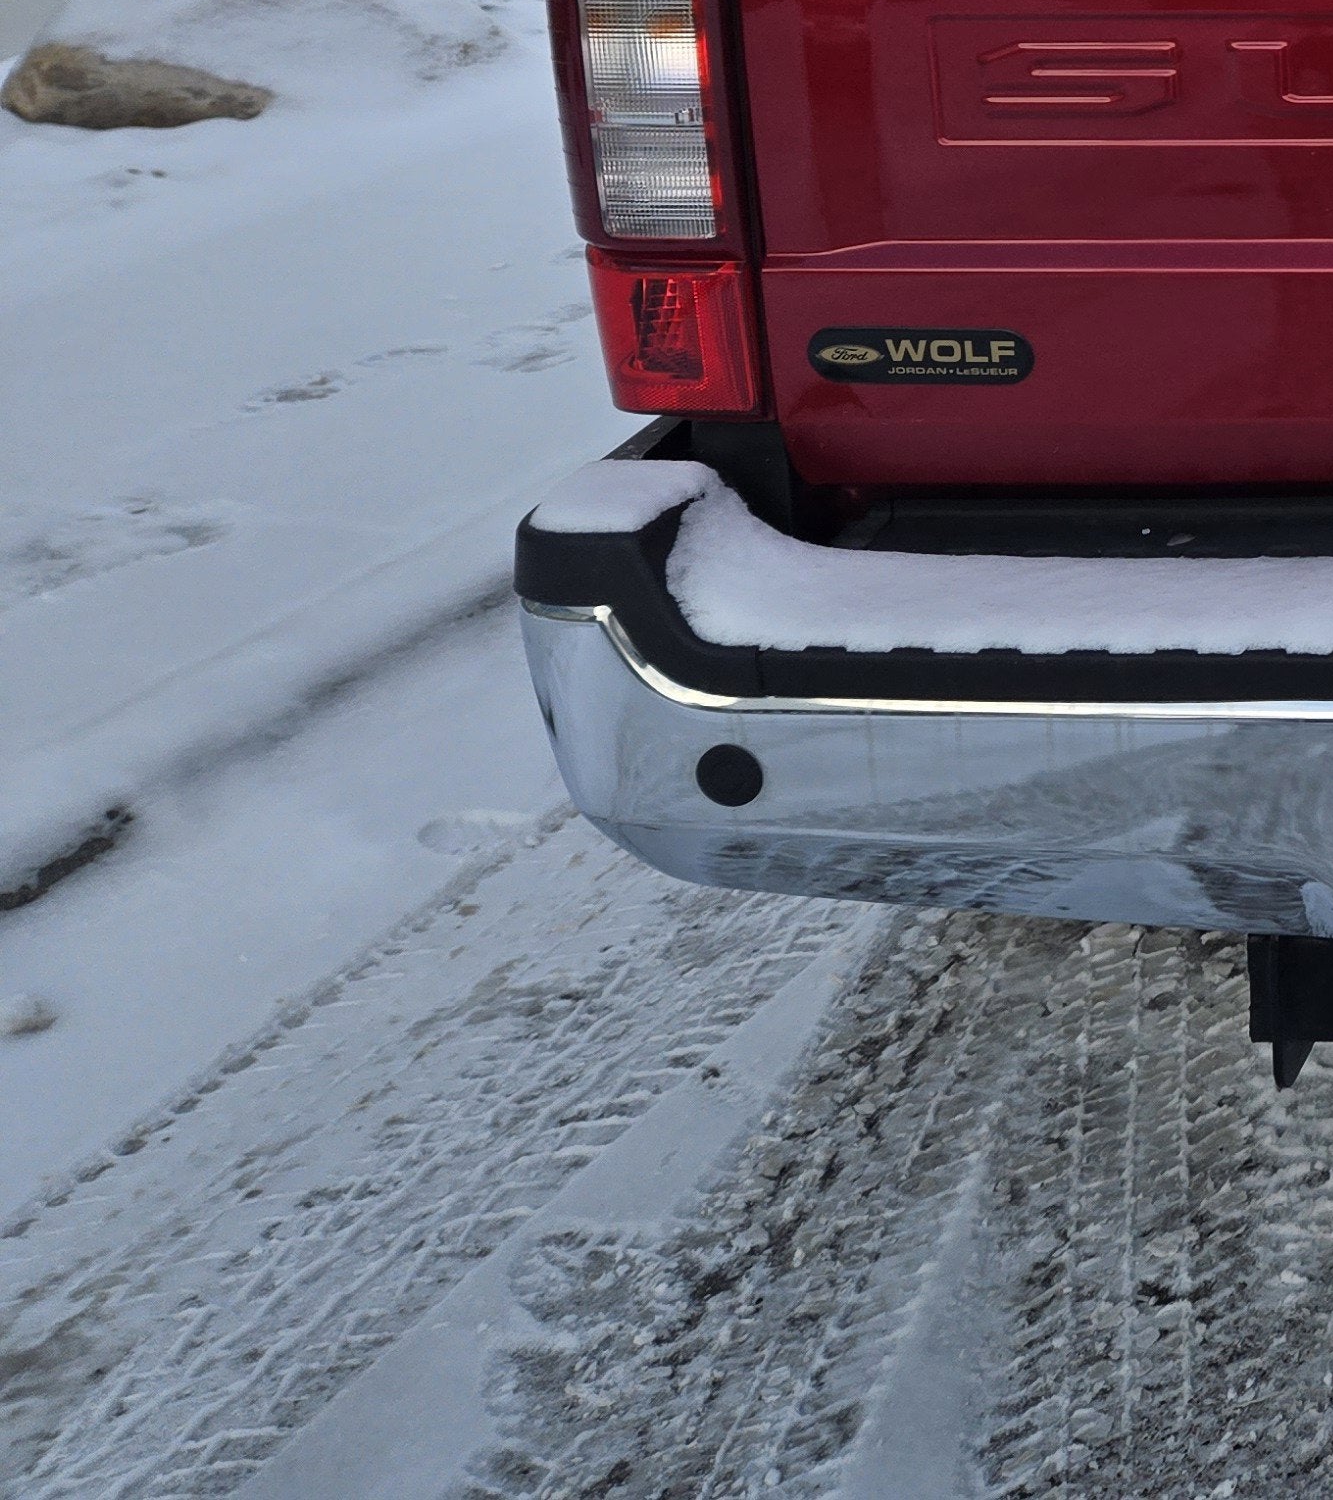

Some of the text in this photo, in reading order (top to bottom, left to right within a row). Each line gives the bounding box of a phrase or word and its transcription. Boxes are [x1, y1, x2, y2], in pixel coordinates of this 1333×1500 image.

[831, 339, 1015, 363] Ford WOLF
[888, 366, 947, 375] JORDAN
